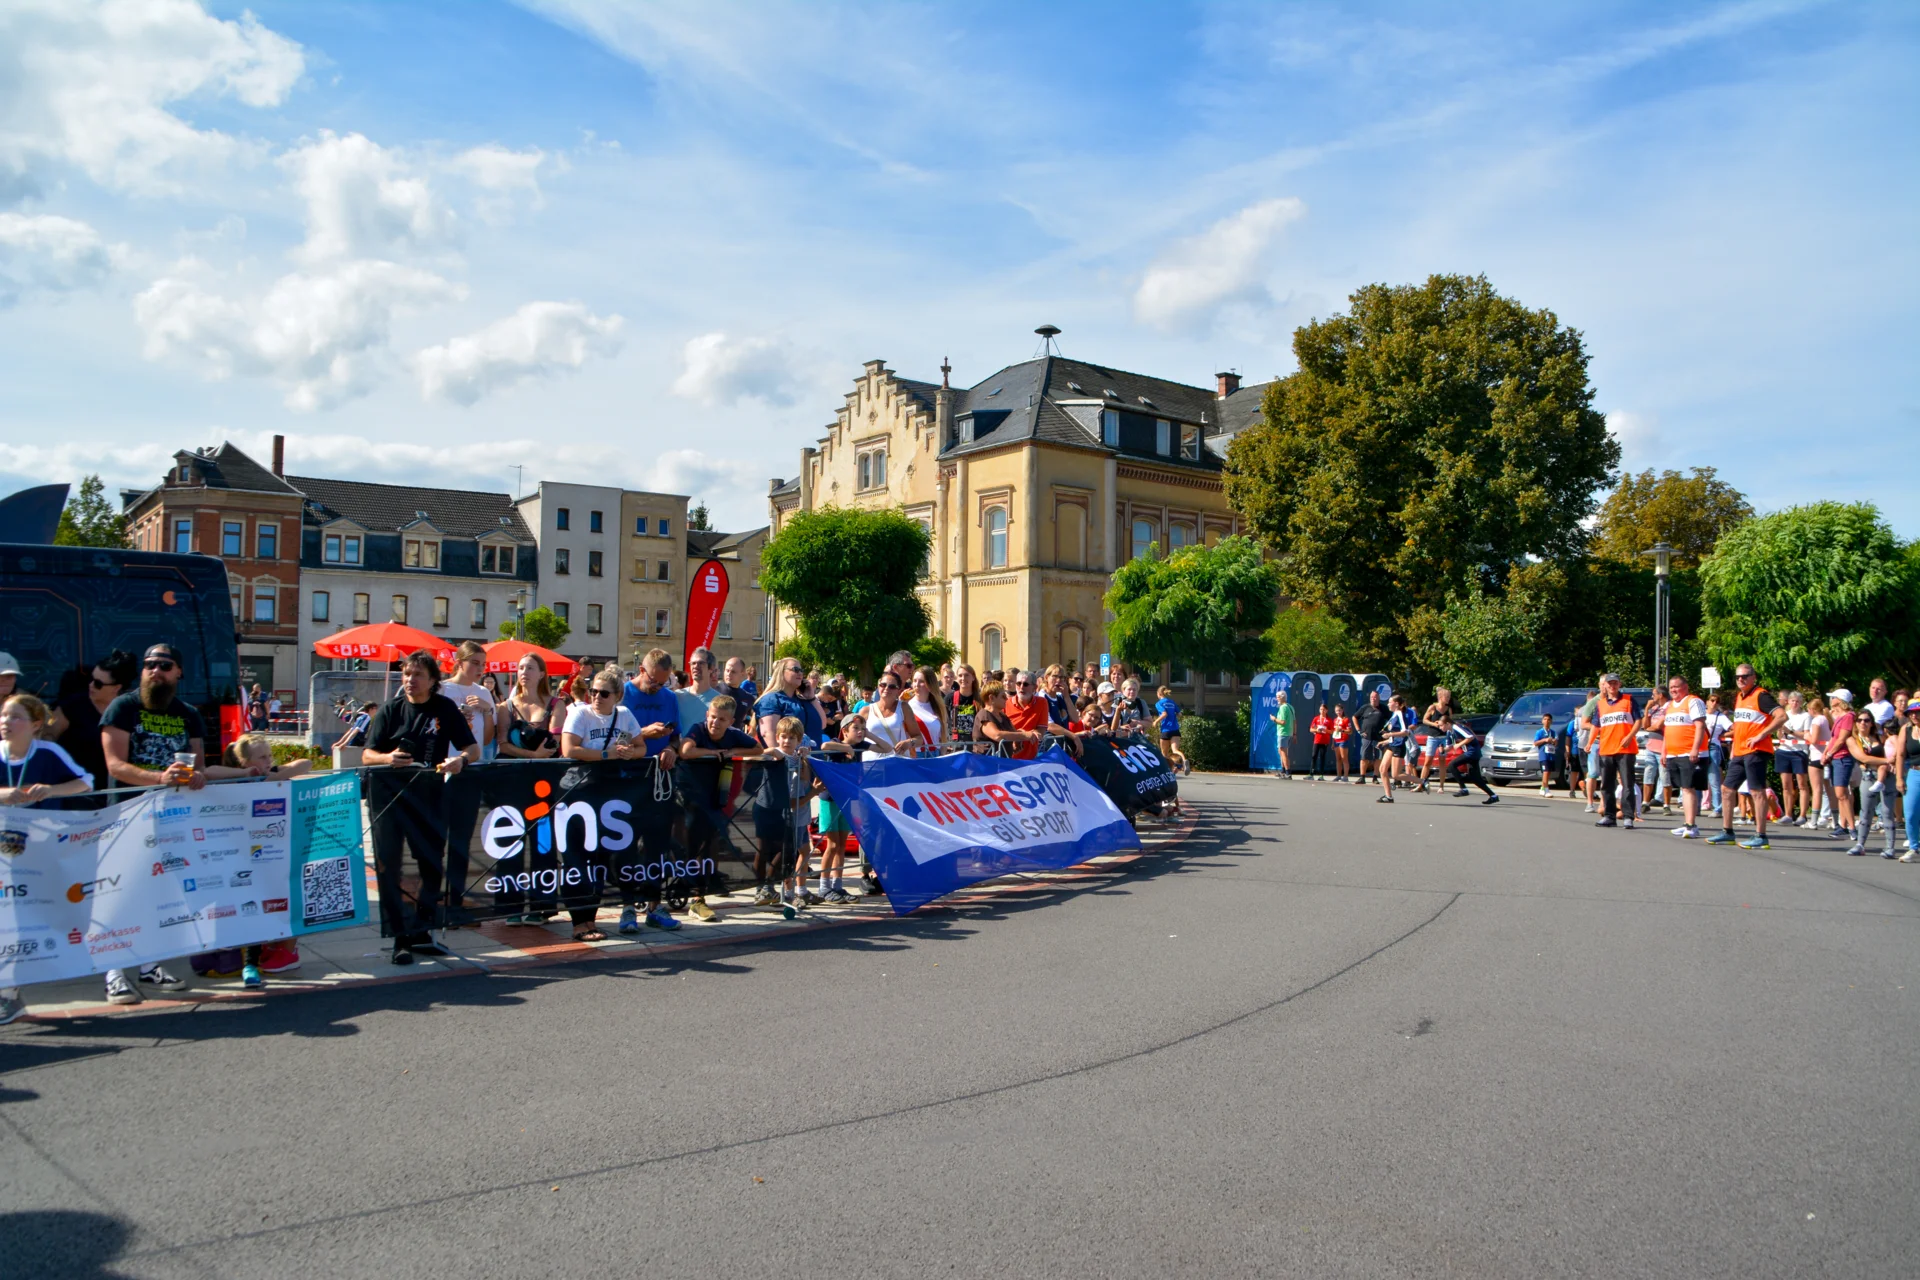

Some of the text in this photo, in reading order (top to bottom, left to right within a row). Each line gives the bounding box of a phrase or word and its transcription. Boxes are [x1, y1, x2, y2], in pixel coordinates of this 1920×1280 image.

[1102, 655, 1108, 666] P
[298, 782, 354, 801] LAUFTREFF
[918, 772, 1078, 826] INTERSPORT
[318, 800, 339, 810] AUGUST
[341, 797, 357, 805] 2025
[481, 780, 634, 859] eins
[991, 810, 1075, 842] GÜ SPORT
[69, 818, 129, 843] INTERSPORT
[80, 873, 122, 896] CTV
[485, 854, 715, 894] energie in sachsen
[87, 925, 142, 942] Sparkasse
[0, 942, 38, 956] USTER
[89, 940, 133, 955] Zwickau
